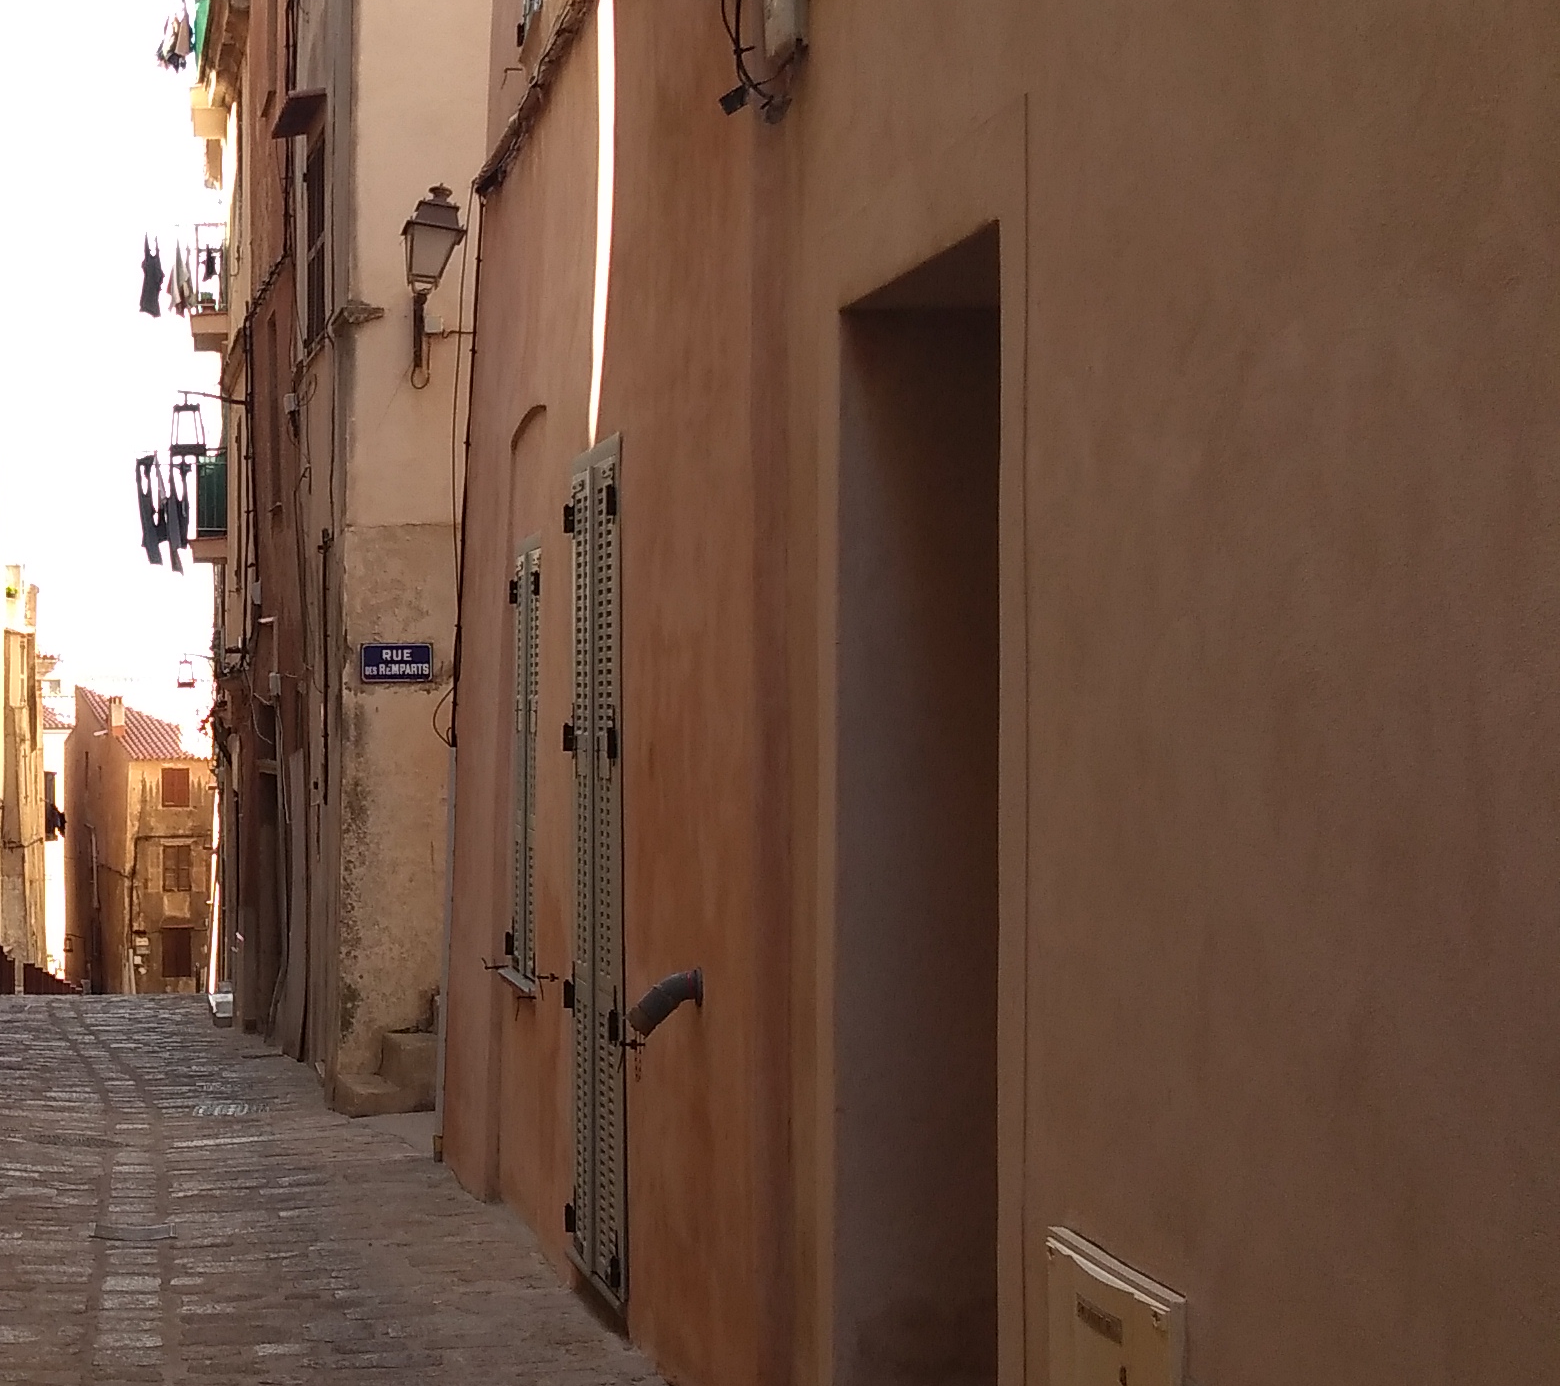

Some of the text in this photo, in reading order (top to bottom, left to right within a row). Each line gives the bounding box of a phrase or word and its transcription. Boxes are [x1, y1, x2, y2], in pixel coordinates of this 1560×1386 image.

[382, 649, 412, 661] RUE
[365, 663, 429, 675] DES REMPARTS
